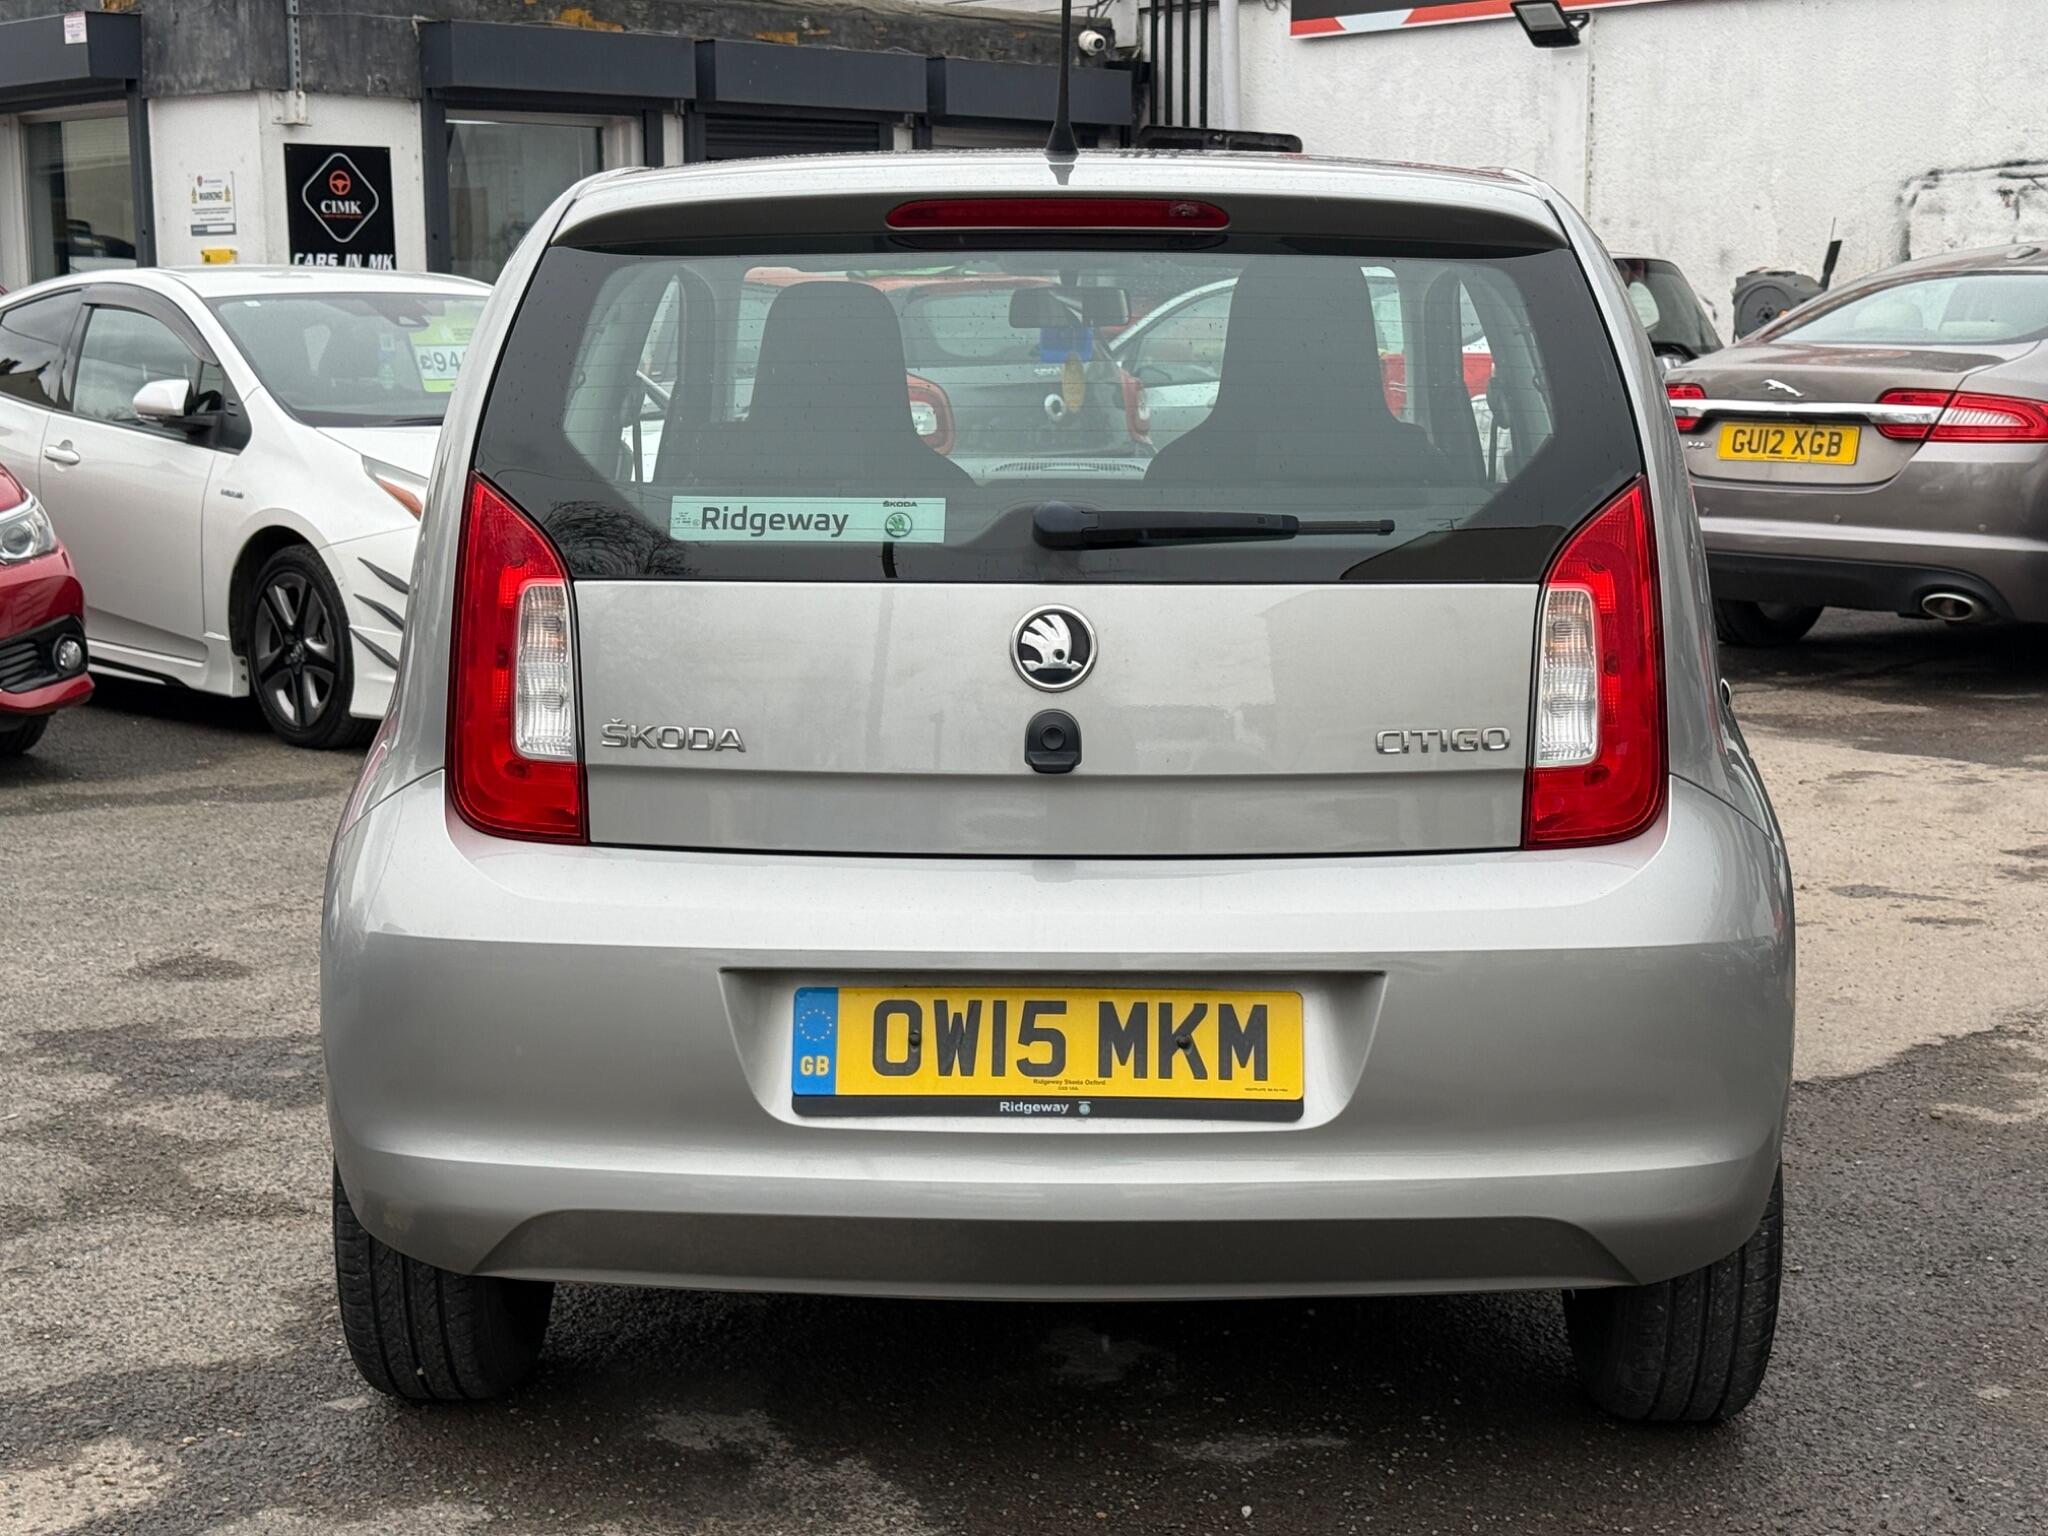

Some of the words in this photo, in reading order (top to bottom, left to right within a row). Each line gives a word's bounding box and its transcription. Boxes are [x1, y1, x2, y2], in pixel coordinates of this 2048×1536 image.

[320, 199, 362, 215] CIMK
[294, 252, 339, 267] CARS
[345, 253, 362, 268] IN
[368, 253, 394, 271] MK
[1731, 429, 1785, 454] GU12
[1791, 430, 1843, 457] XGB
[701, 505, 849, 538] Ridgeway
[601, 717, 747, 753] ŠKODA
[1376, 727, 1512, 755] CITIGO
[872, 999, 1067, 1078] OW15
[1098, 1001, 1268, 1081] MKM
[800, 1055, 830, 1076] GB
[999, 1100, 1070, 1115] Ridgeway
